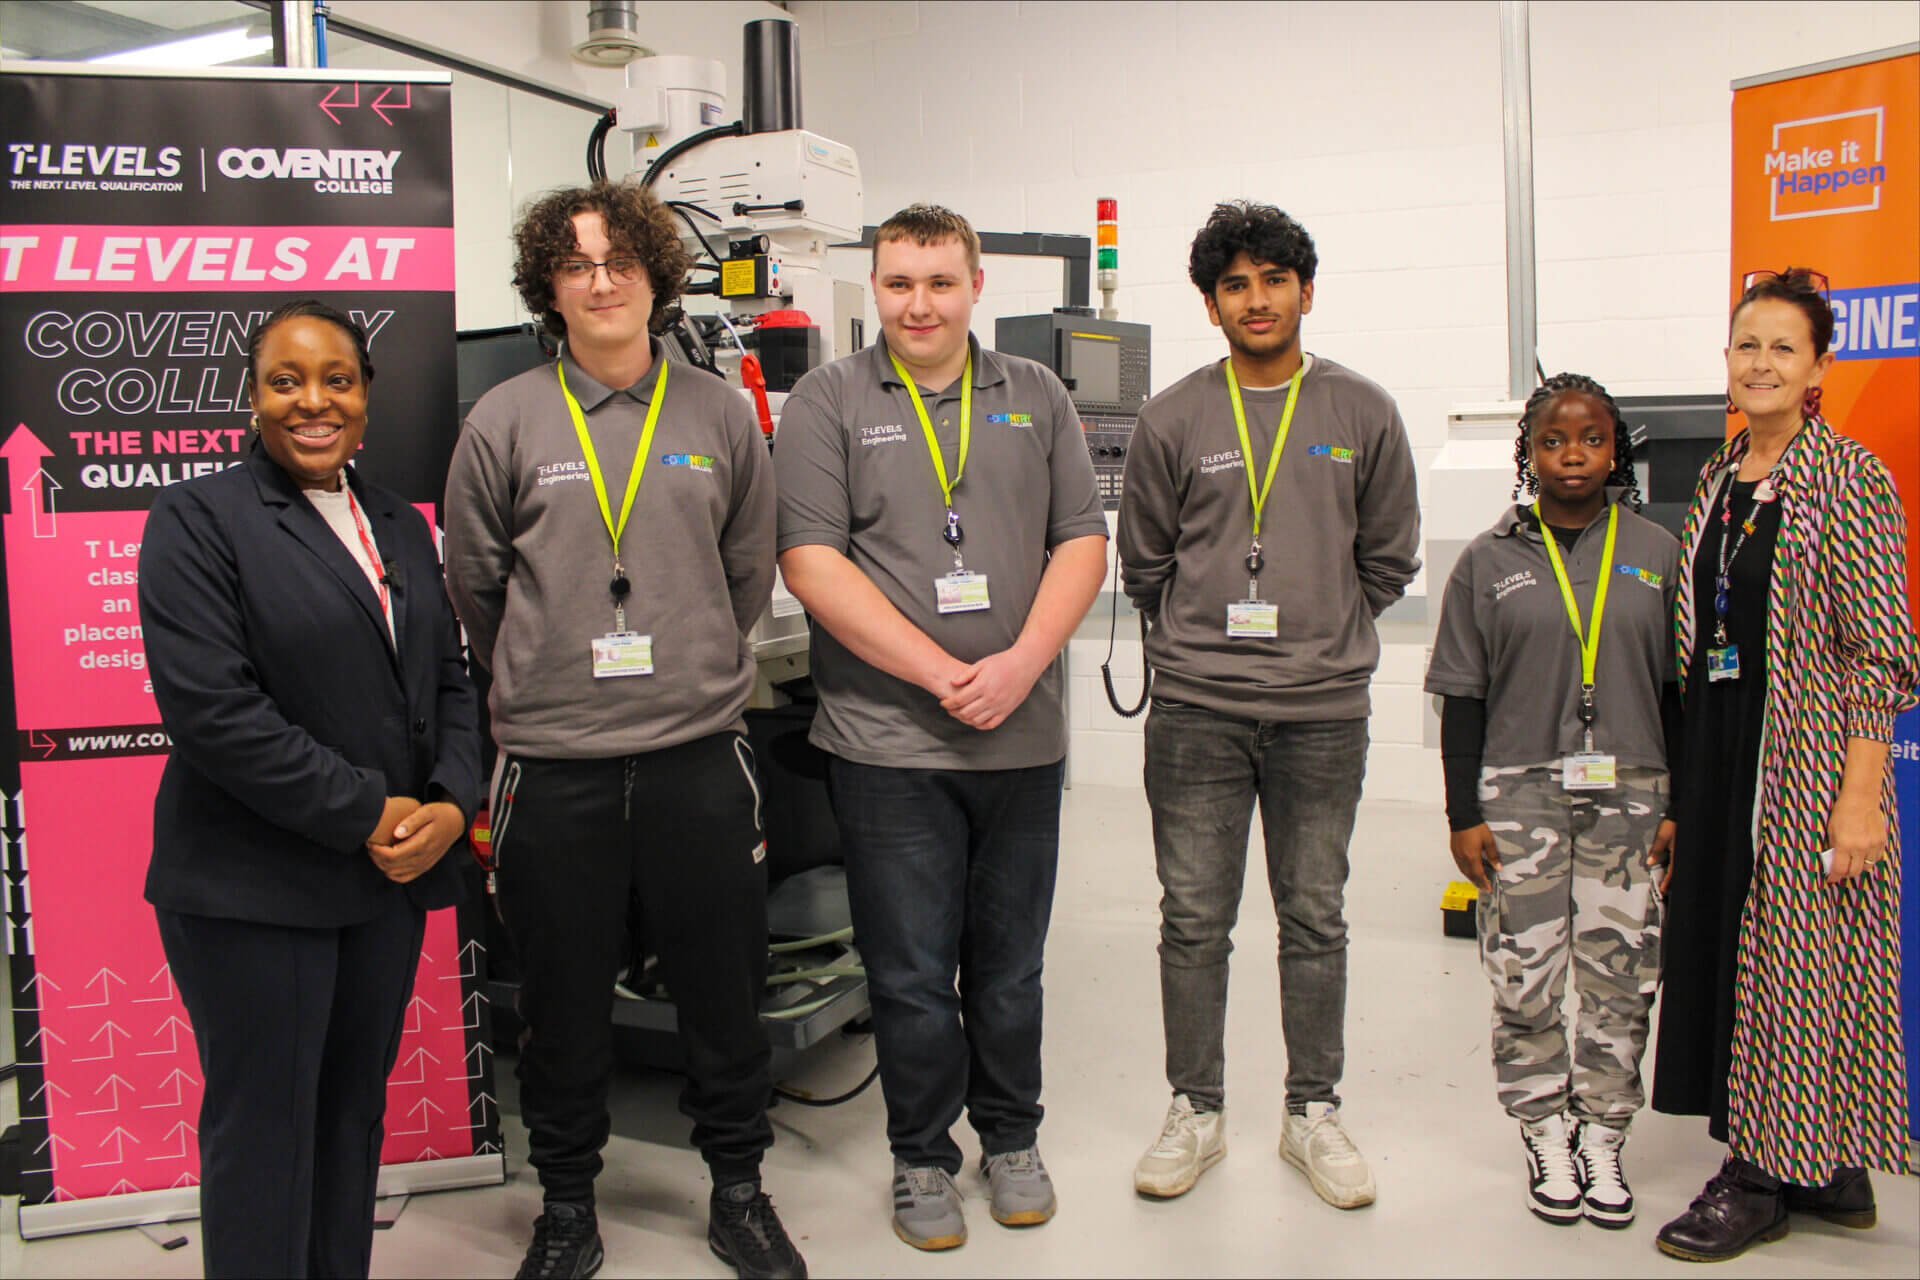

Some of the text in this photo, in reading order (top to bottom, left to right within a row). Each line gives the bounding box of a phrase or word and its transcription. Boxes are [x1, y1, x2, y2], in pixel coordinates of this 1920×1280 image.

[9, 144, 182, 177] T-LEVELS
[217, 149, 402, 180] COVENTRY
[1764, 141, 1860, 175] Make it
[11, 180, 183, 192] THE NEXT LEVEL QUALIFICATION
[315, 181, 393, 194] COLLEGE
[1778, 165, 1886, 195] Happen
[0, 236, 415, 282] T LEVELS AT
[25, 310, 395, 359] COVENY
[862, 425, 903, 437] T-LEVELS
[862, 433, 907, 446] Engineering
[69, 429, 246, 456] THE NEXT
[80, 461, 243, 488] QUALIF
[537, 461, 586, 476] T-LEVELS
[538, 472, 590, 486] Engineering
[84, 540, 142, 558] T Le
[88, 567, 138, 586] clas
[102, 598, 132, 613] an
[79, 649, 146, 670] desig
